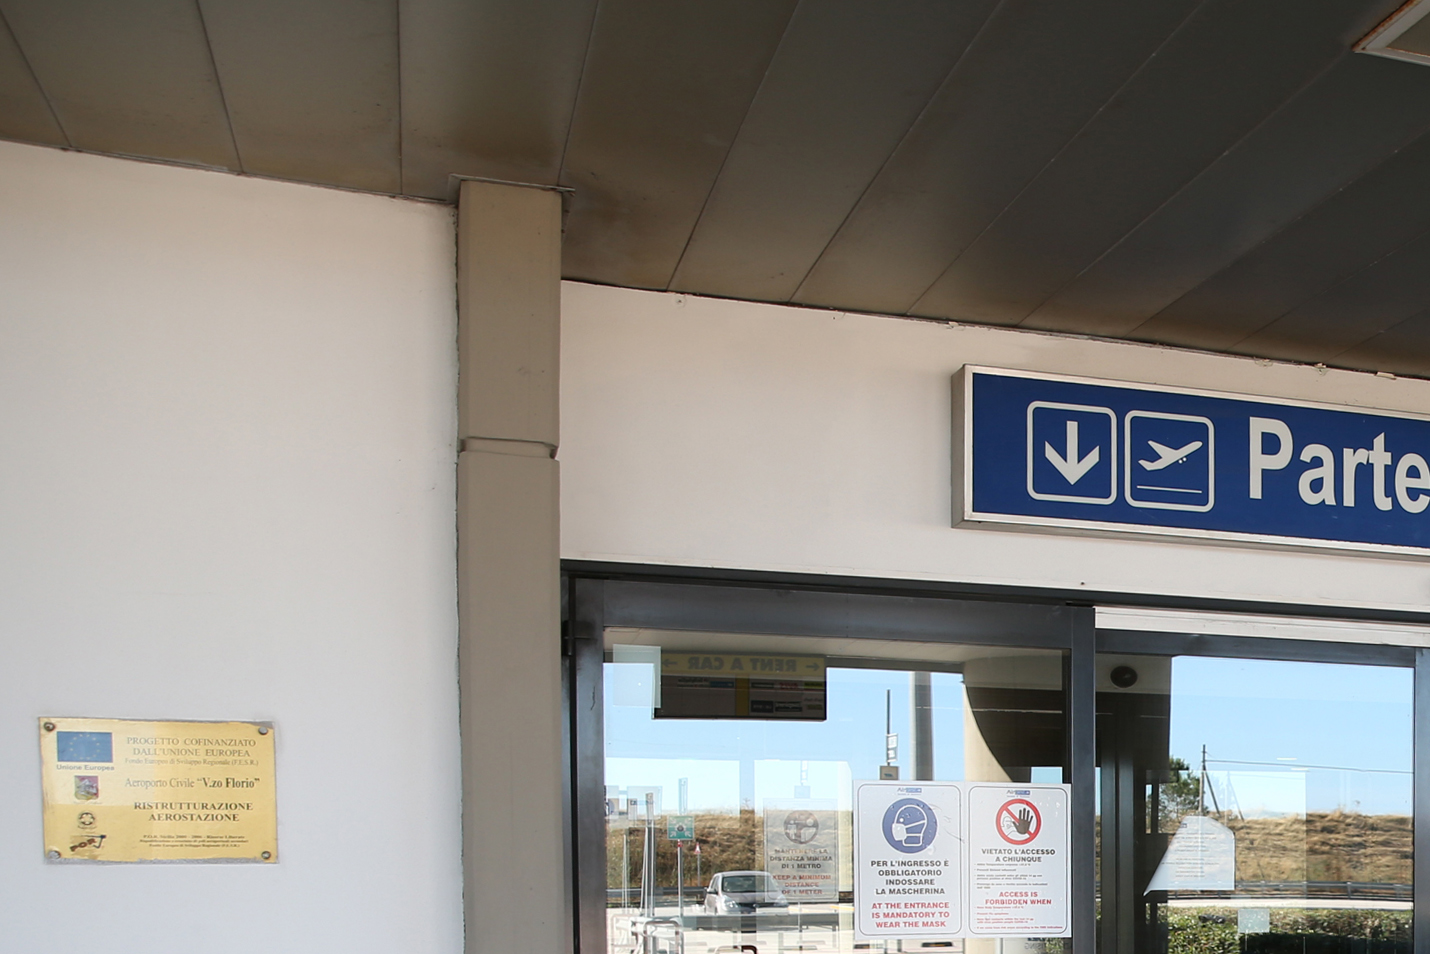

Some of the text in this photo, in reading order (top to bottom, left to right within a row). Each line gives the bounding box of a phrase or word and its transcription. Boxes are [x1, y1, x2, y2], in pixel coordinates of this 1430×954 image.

[126, 736, 257, 747] PROGETTO COFINANZIATO
[133, 747, 251, 757] DALL'UNIONE EUROPEA
[84, 764, 115, 772] Europea
[124, 778, 168, 790] Aeroporto
[169, 777, 195, 788] Civile
[133, 801, 254, 811] RISTRUTTURAZIONE
[148, 813, 240, 822] AEROSTAZIONE
[1014, 848, 1056, 856] L'ACCESSO
[769, 855, 806, 863] DISTANZA
[796, 862, 822, 870] METRO
[870, 860, 889, 868] PER
[878, 869, 943, 877] OBBLIGATORIO
[784, 881, 820, 889] DISTANCE
[885, 878, 936, 886] INDOSSARE
[875, 888, 887, 896] LA
[871, 902, 883, 910] AT
[903, 901, 950, 909] ENTRANCE
[882, 911, 936, 919] MANDATORY
